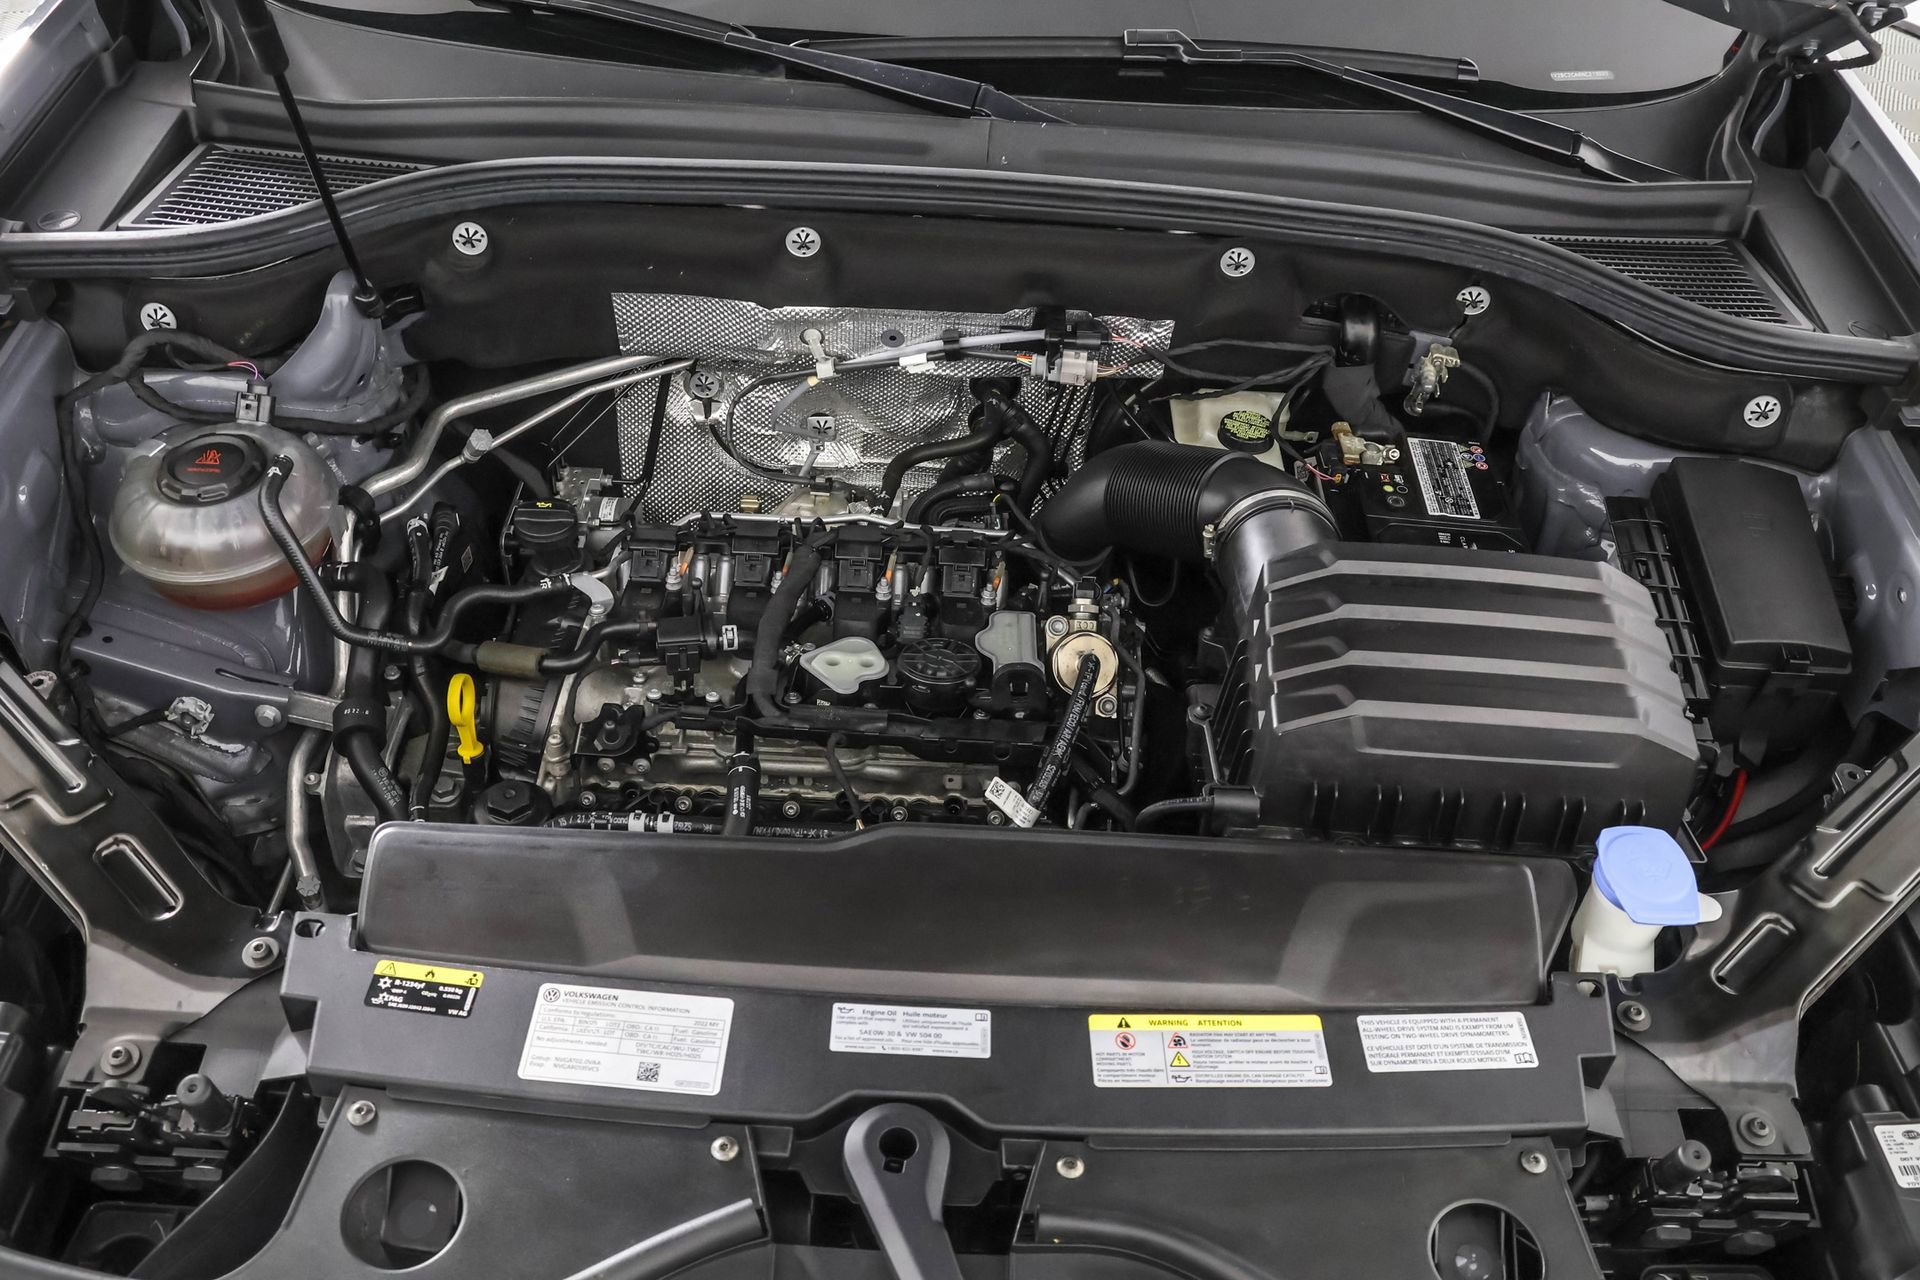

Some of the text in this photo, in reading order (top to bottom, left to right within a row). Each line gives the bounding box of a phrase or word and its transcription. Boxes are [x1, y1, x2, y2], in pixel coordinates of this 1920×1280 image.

[563, 990, 618, 1000] VOLKSWAGEN
[648, 1005, 690, 1013] INFORMATION
[862, 1008, 884, 1016] Engine
